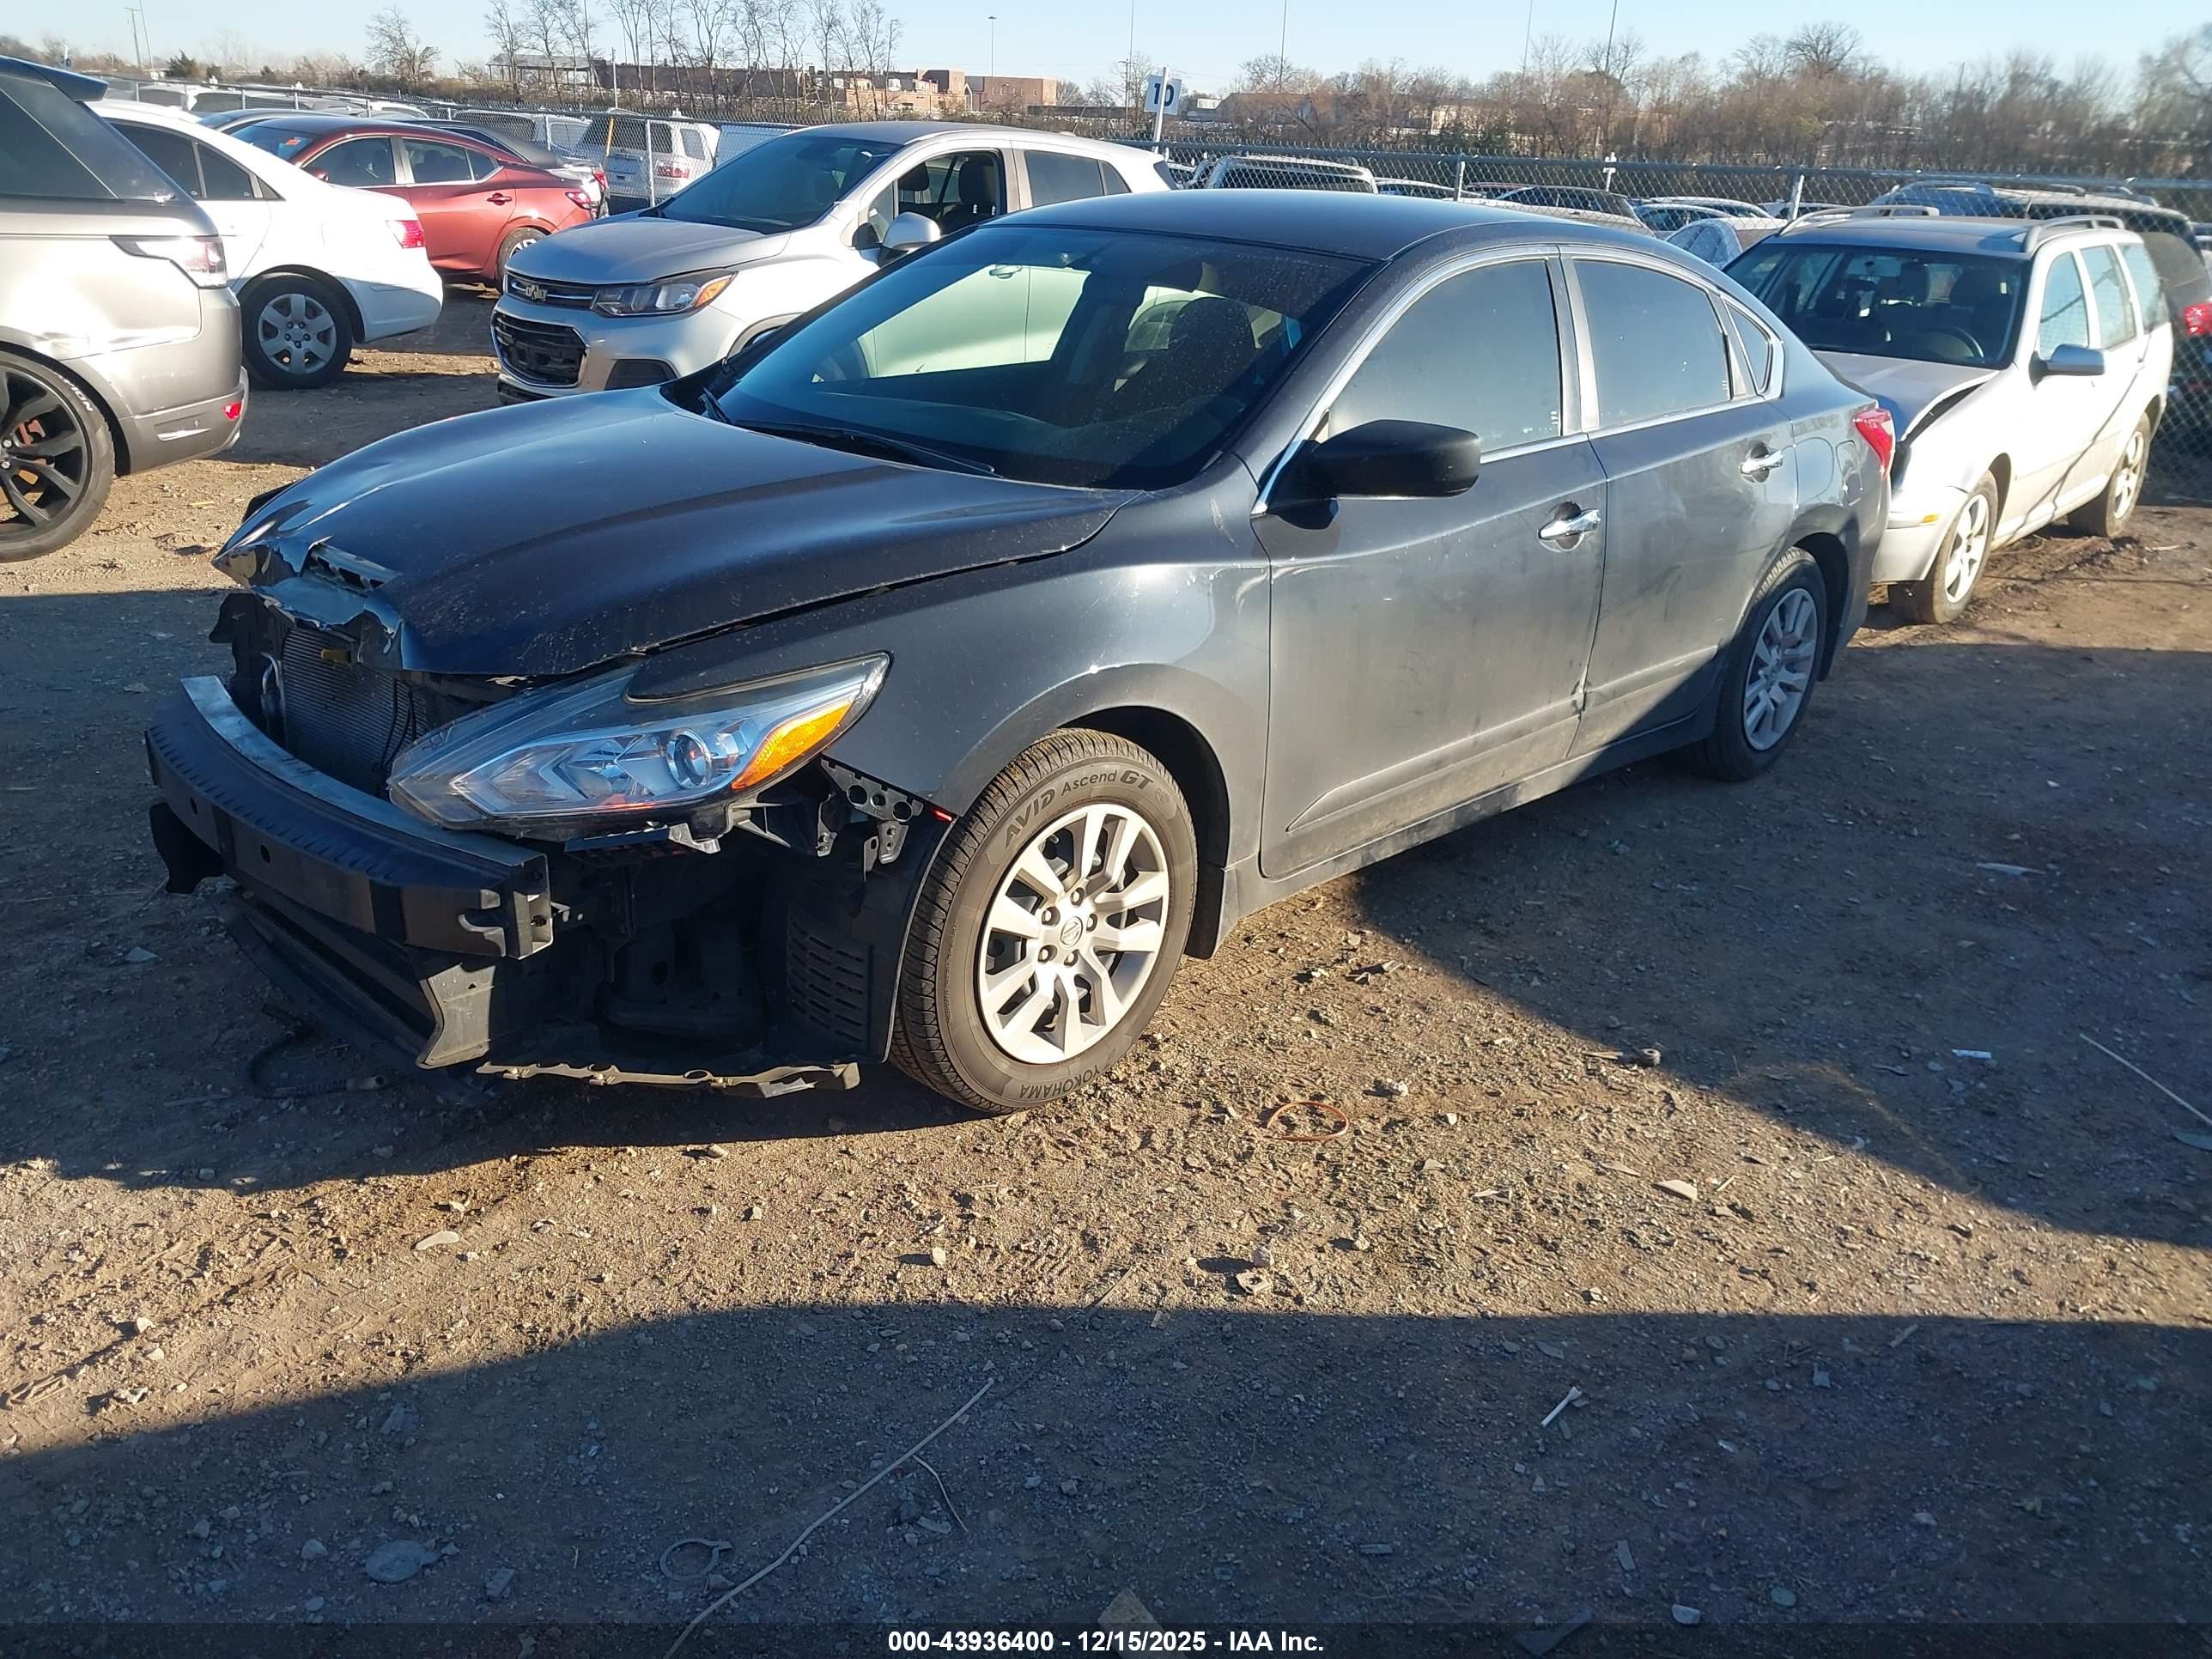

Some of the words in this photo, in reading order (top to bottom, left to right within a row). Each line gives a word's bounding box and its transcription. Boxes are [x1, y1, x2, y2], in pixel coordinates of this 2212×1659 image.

[1153, 82, 1175, 107] 10
[1005, 788, 1055, 849] AVID
[1060, 769, 1118, 797] Ascend
[1119, 769, 1155, 790] GT
[1019, 1064, 1101, 1099] YOKOHAMA
